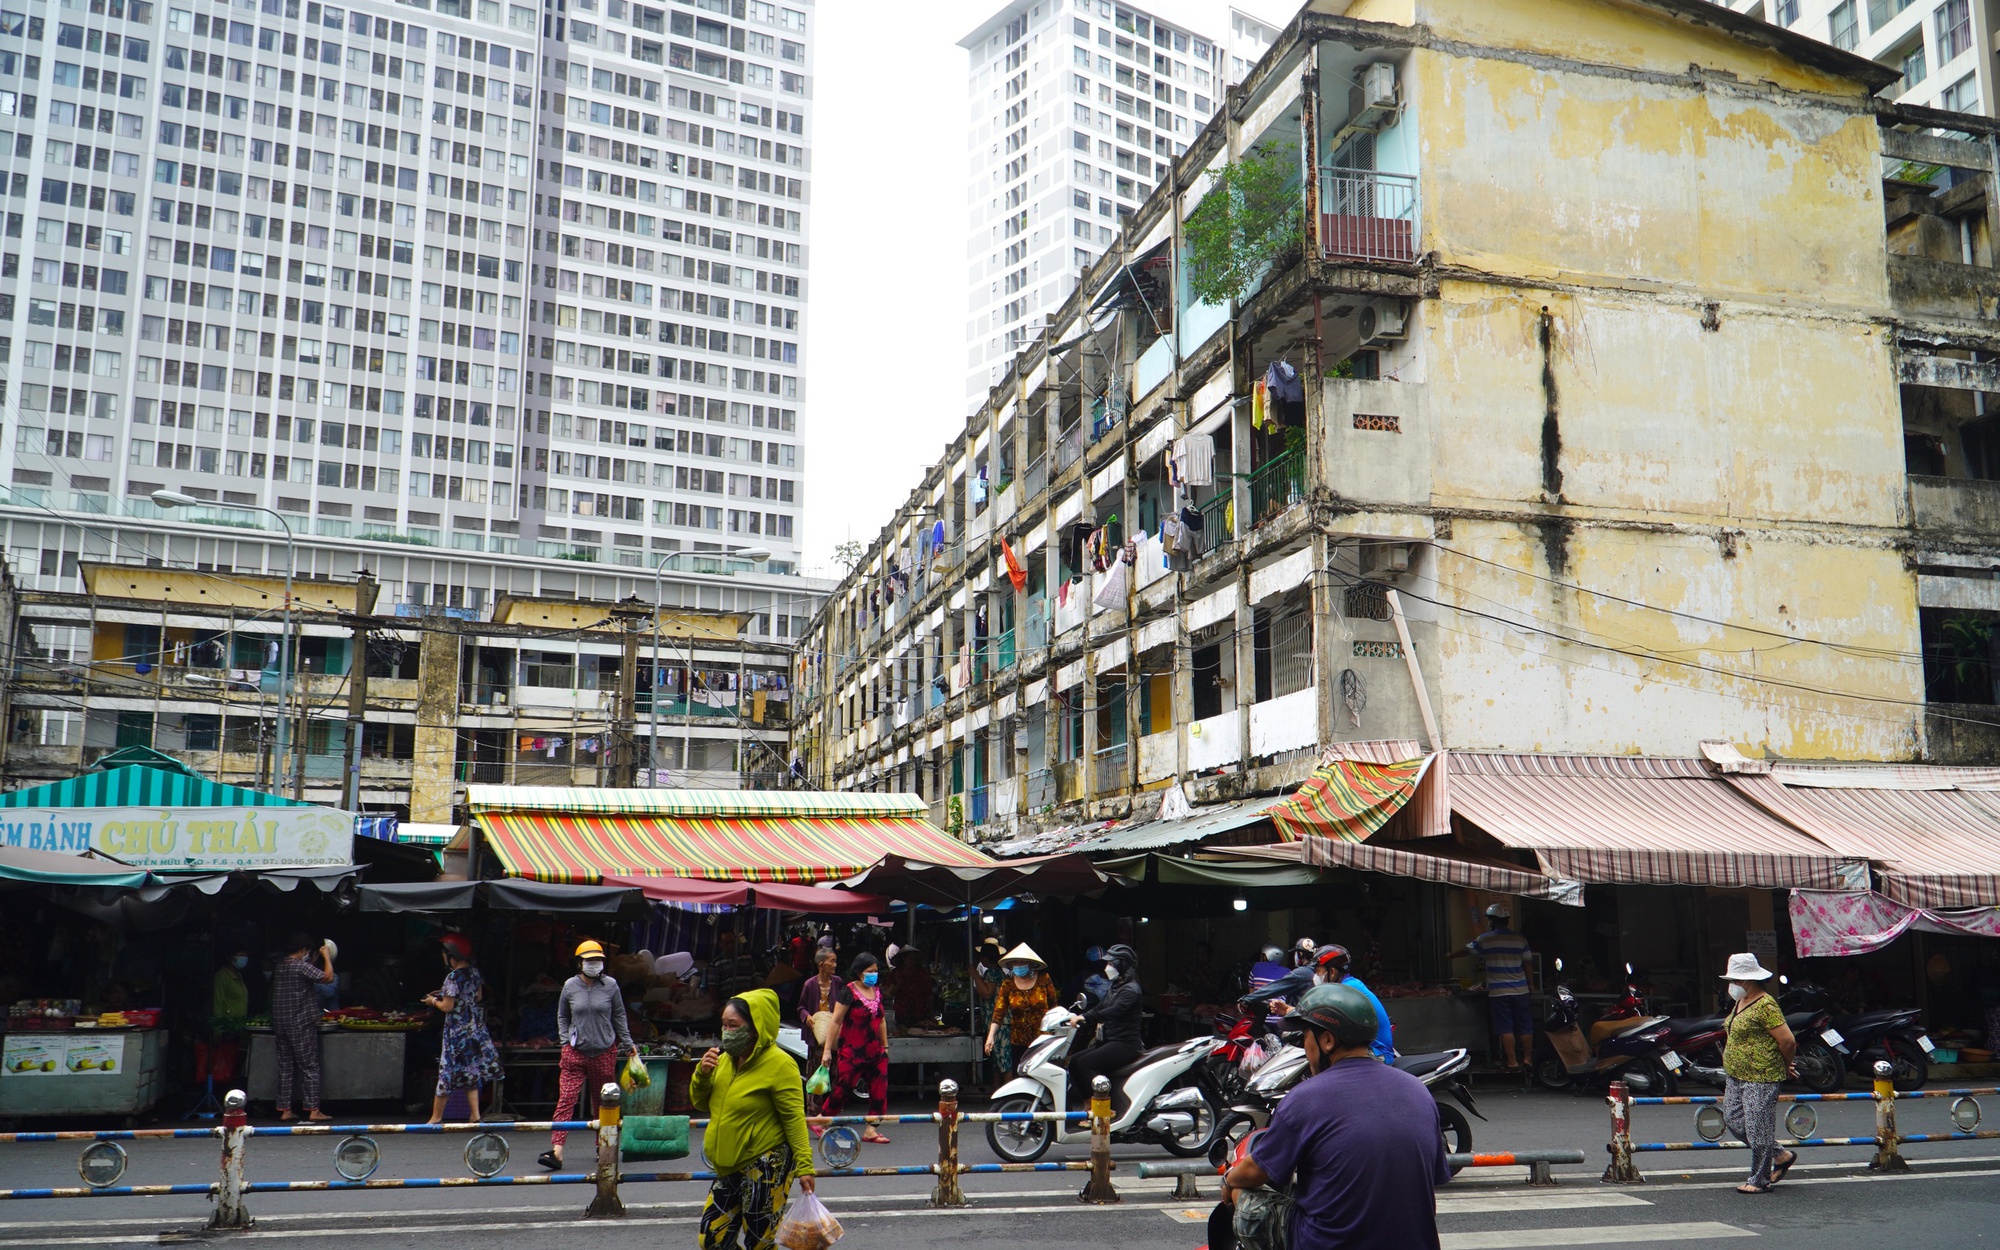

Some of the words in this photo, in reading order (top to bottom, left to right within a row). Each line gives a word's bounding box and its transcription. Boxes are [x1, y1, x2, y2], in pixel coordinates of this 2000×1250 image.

[28, 814, 92, 851] BÁNH
[100, 810, 179, 855] CHÚ
[186, 811, 279, 854] THÁI
[1312, 1012, 1341, 1024] HONDA
